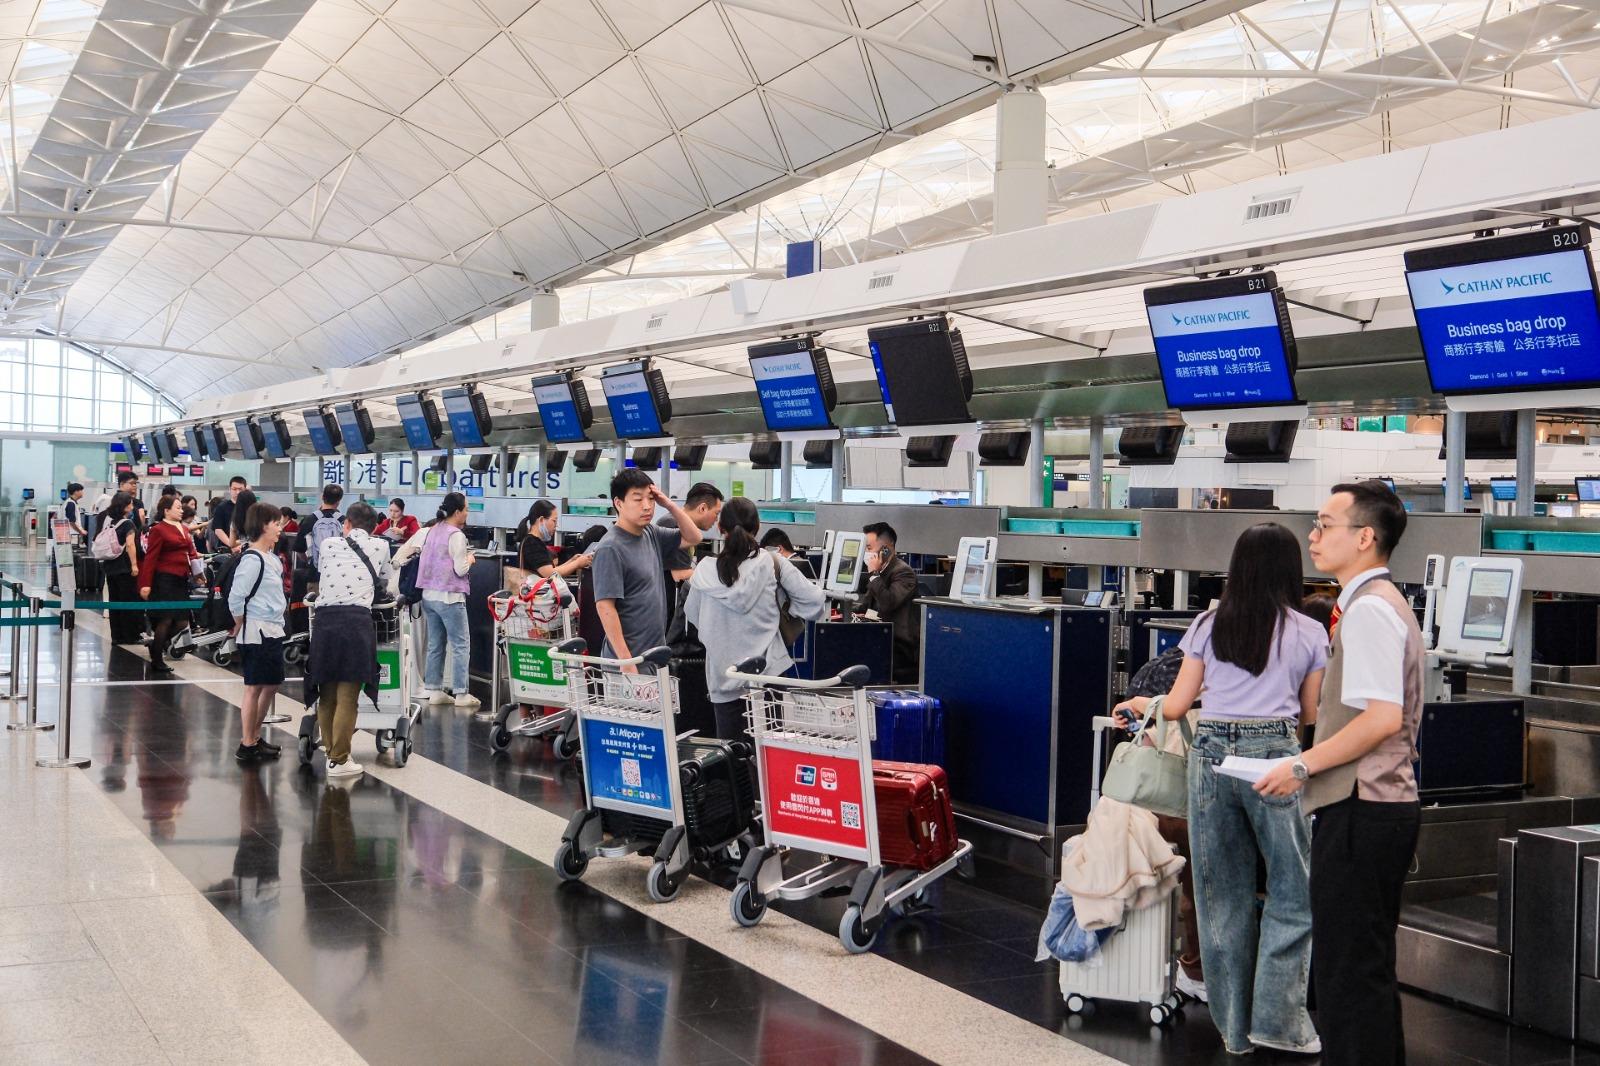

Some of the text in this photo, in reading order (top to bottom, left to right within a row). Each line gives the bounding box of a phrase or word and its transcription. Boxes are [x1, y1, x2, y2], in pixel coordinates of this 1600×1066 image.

[1553, 231, 1579, 247] B20
[1248, 278, 1266, 290] B21
[1458, 272, 1553, 294] CATHAY PACIFIC
[1184, 309, 1251, 326] CATHAY PACIFIC
[1447, 315, 1567, 338] Business bag drop
[1513, 333, 1581, 351] 公务行李托运
[1177, 345, 1261, 362] Business bag drop
